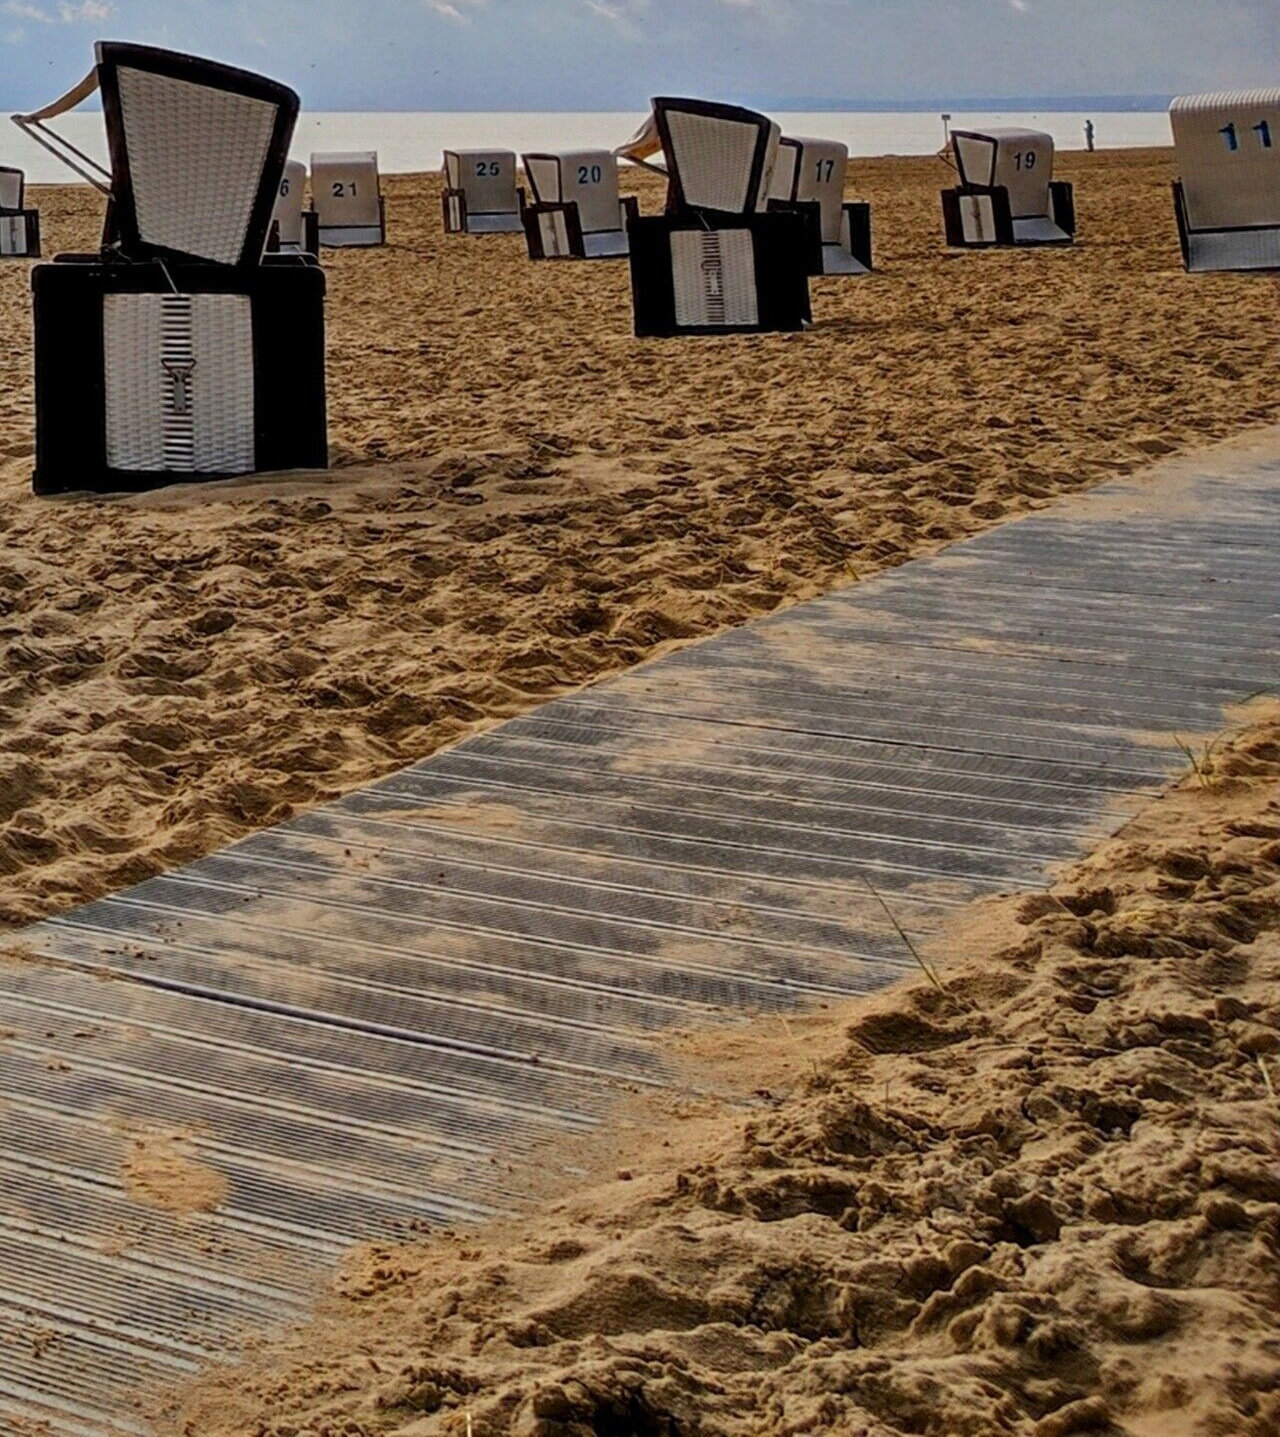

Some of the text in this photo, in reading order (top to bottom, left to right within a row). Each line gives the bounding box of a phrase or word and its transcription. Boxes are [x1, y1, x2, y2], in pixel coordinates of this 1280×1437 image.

[1219, 120, 1271, 150] 11
[476, 162, 500, 176] 25
[1014, 151, 1035, 170] 19
[578, 166, 601, 184] 20
[816, 159, 834, 183] 17
[333, 183, 356, 197] 21
